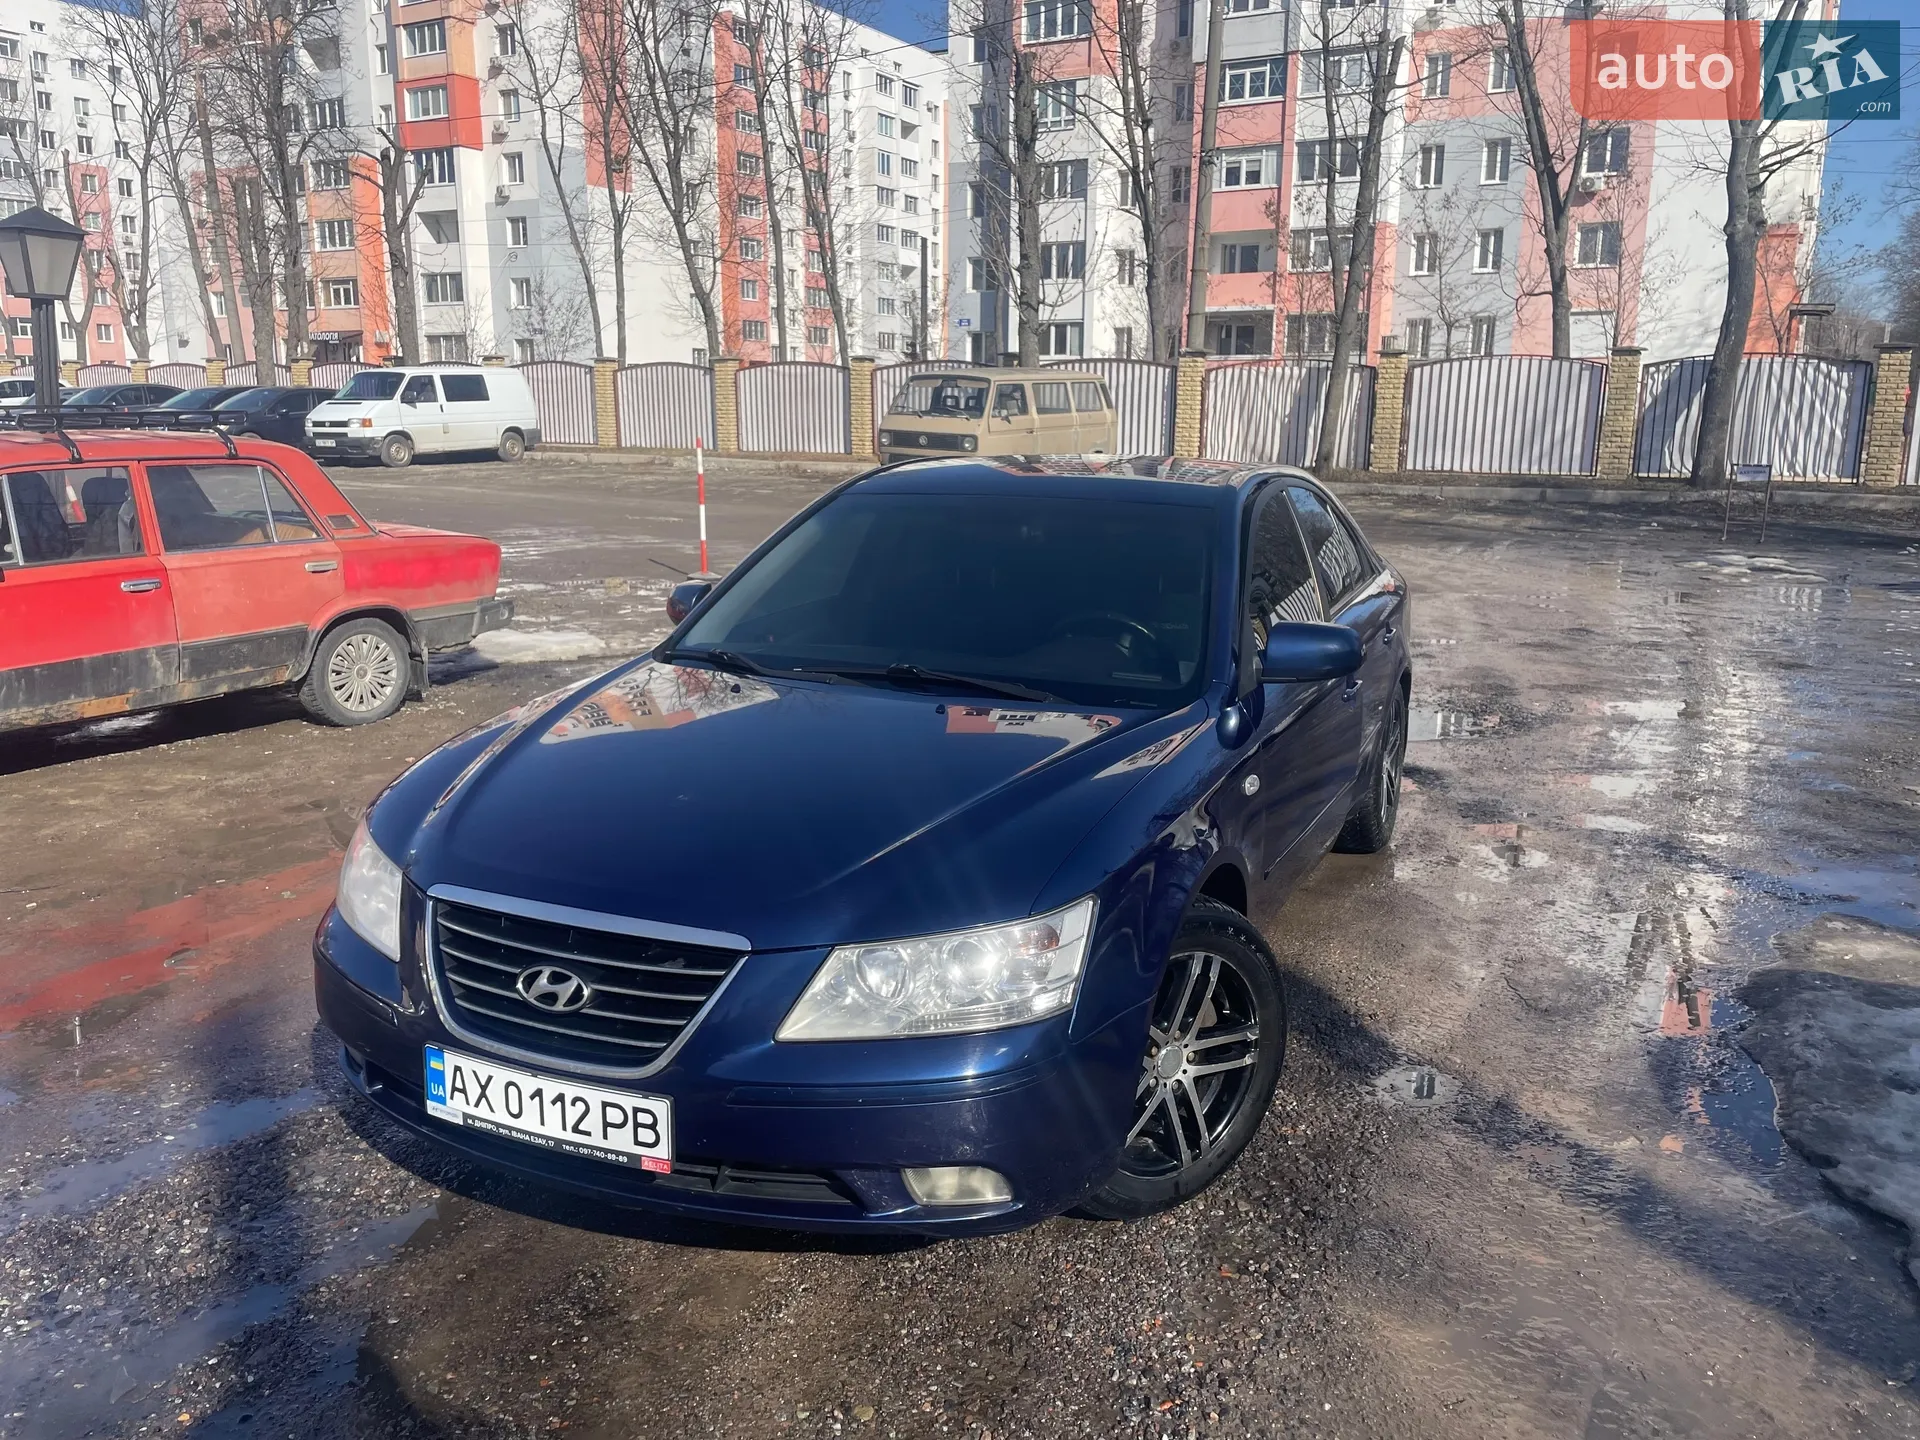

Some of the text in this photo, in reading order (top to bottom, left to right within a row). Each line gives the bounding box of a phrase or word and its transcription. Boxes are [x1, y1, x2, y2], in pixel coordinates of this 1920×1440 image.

[431, 1081, 445, 1098] UA
[449, 1064, 661, 1149] AX 0112 PB
[578, 1146, 628, 1163] 097-740-89-89
